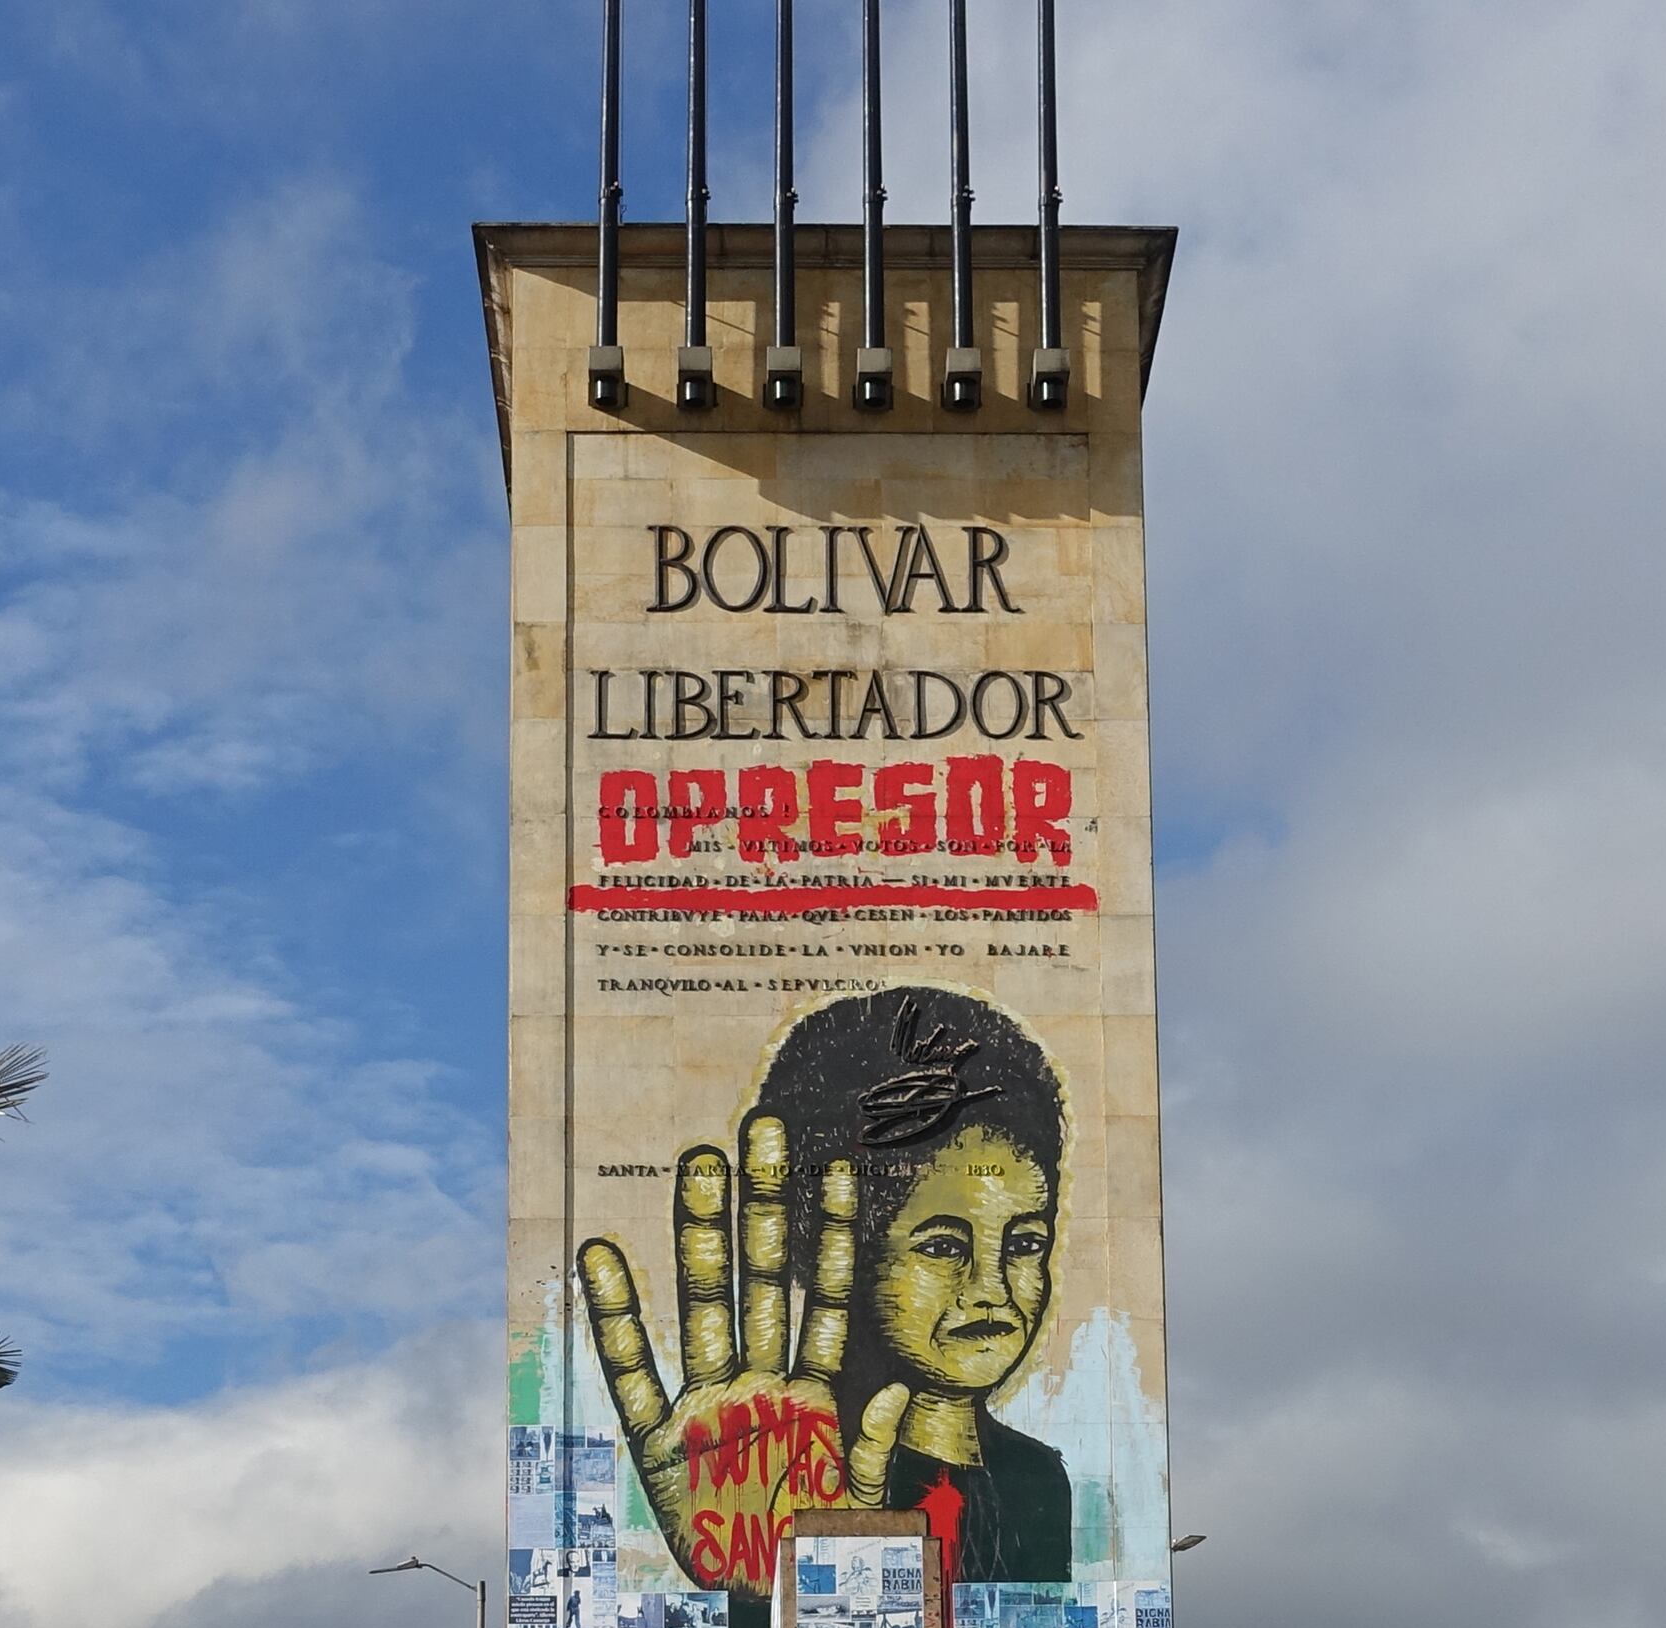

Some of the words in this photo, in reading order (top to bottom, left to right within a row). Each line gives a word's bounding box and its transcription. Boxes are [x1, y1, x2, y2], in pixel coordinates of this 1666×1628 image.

[647, 524, 1025, 615] BOLIVAR
[588, 670, 1083, 740] LIBERTADOR
[599, 754, 1072, 868] OPRESOR
[687, 840, 722, 853] MIS
[599, 875, 709, 888] FELICIDAD
[725, 875, 750, 888] DE
[765, 875, 789, 888] LA
[802, 875, 874, 888] PATRIA
[911, 875, 932, 888] SI
[944, 875, 968, 888] MI
[739, 910, 789, 922] PARA
[855, 910, 914, 922] CESEN
[935, 910, 970, 922] LOS
[983, 910, 1072, 922] PARTIDOS
[623, 944, 648, 957] SE
[664, 944, 789, 957] CONSOLIDE
[802, 944, 830, 957] LA
[936, 944, 965, 957] YO
[724, 979, 750, 991] AL
[597, 1164, 659, 1178] SANTA
